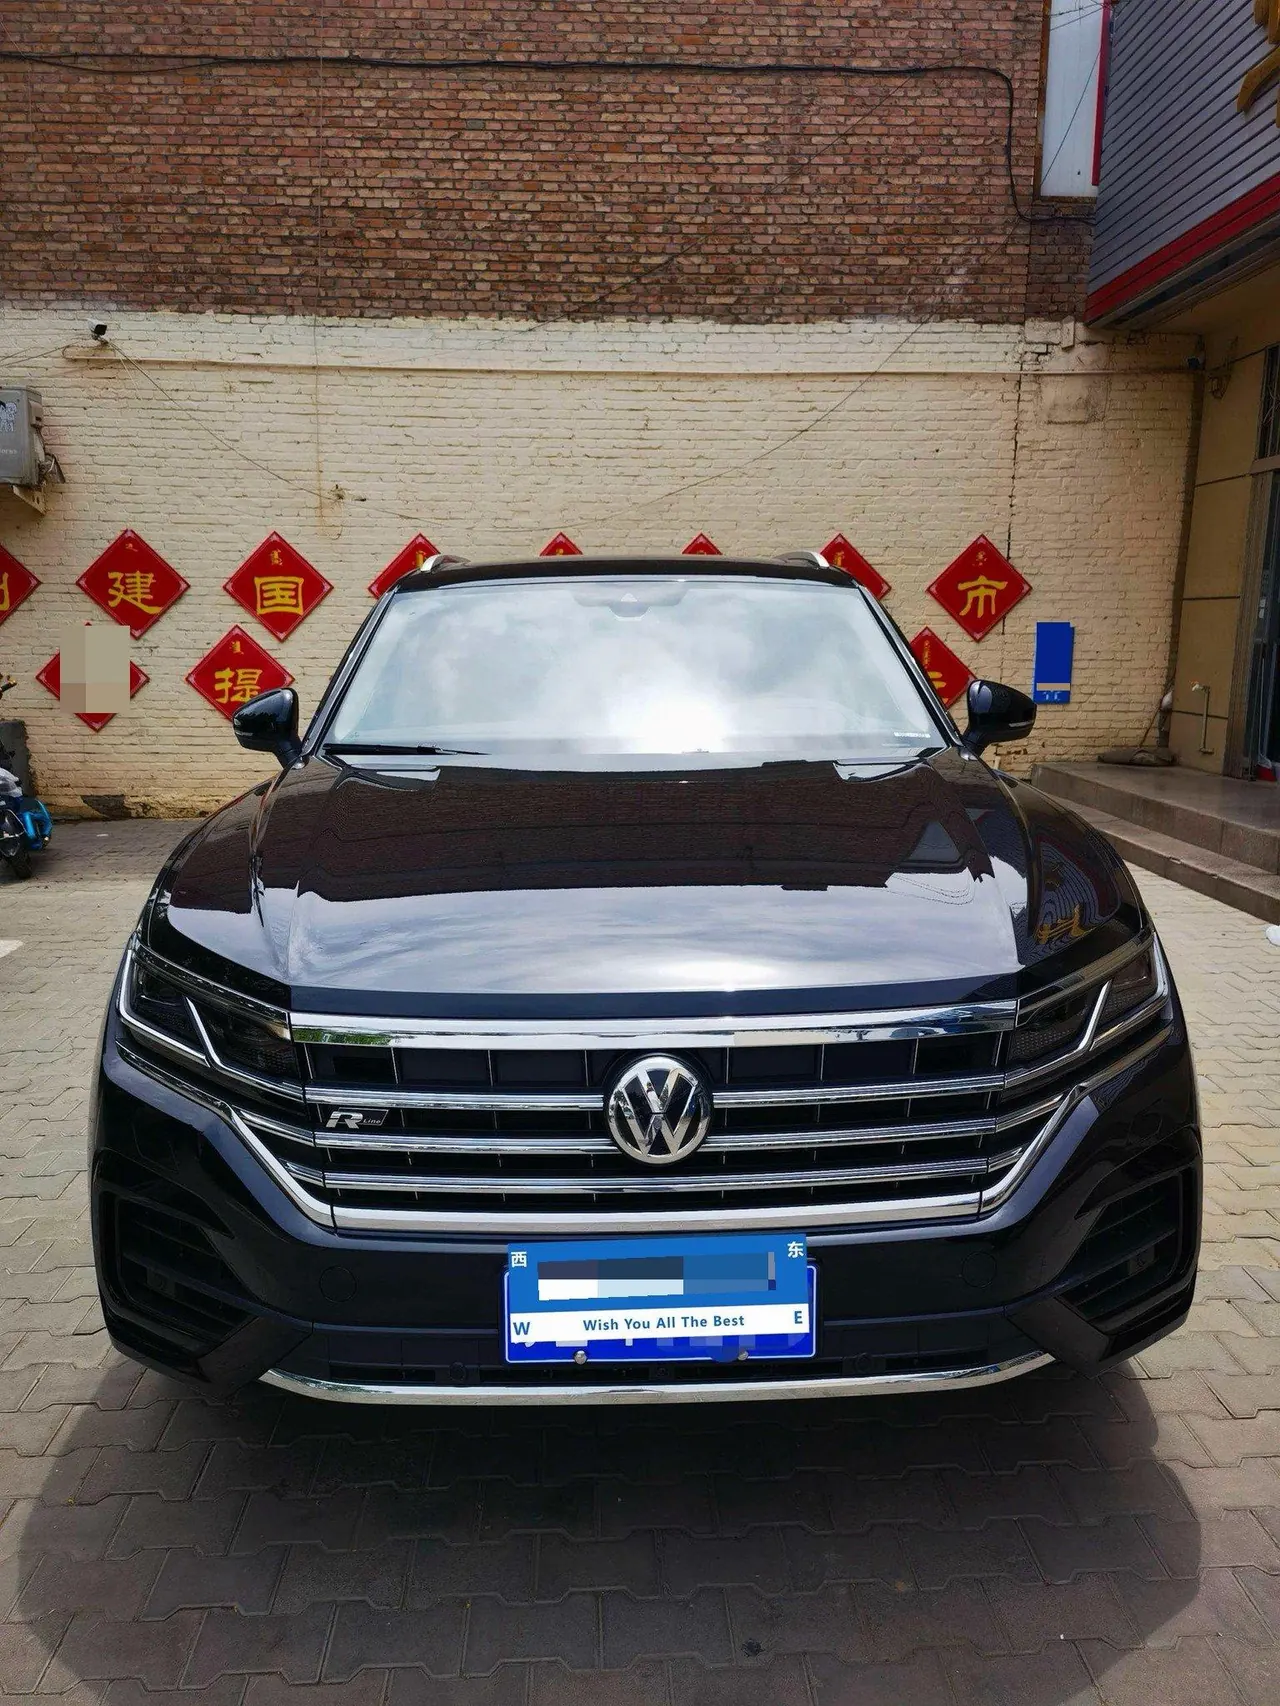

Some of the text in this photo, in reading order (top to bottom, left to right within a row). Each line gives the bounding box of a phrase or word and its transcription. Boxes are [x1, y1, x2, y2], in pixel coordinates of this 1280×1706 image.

[107, 570, 163, 615] 建
[253, 575, 305, 616] 国
[957, 575, 1008, 618] 市
[787, 1241, 804, 1258] 东
[510, 1251, 527, 1267] 西
[583, 1315, 745, 1331] Wish You All The Best
[794, 1310, 803, 1324] E
[512, 1321, 531, 1335] W
